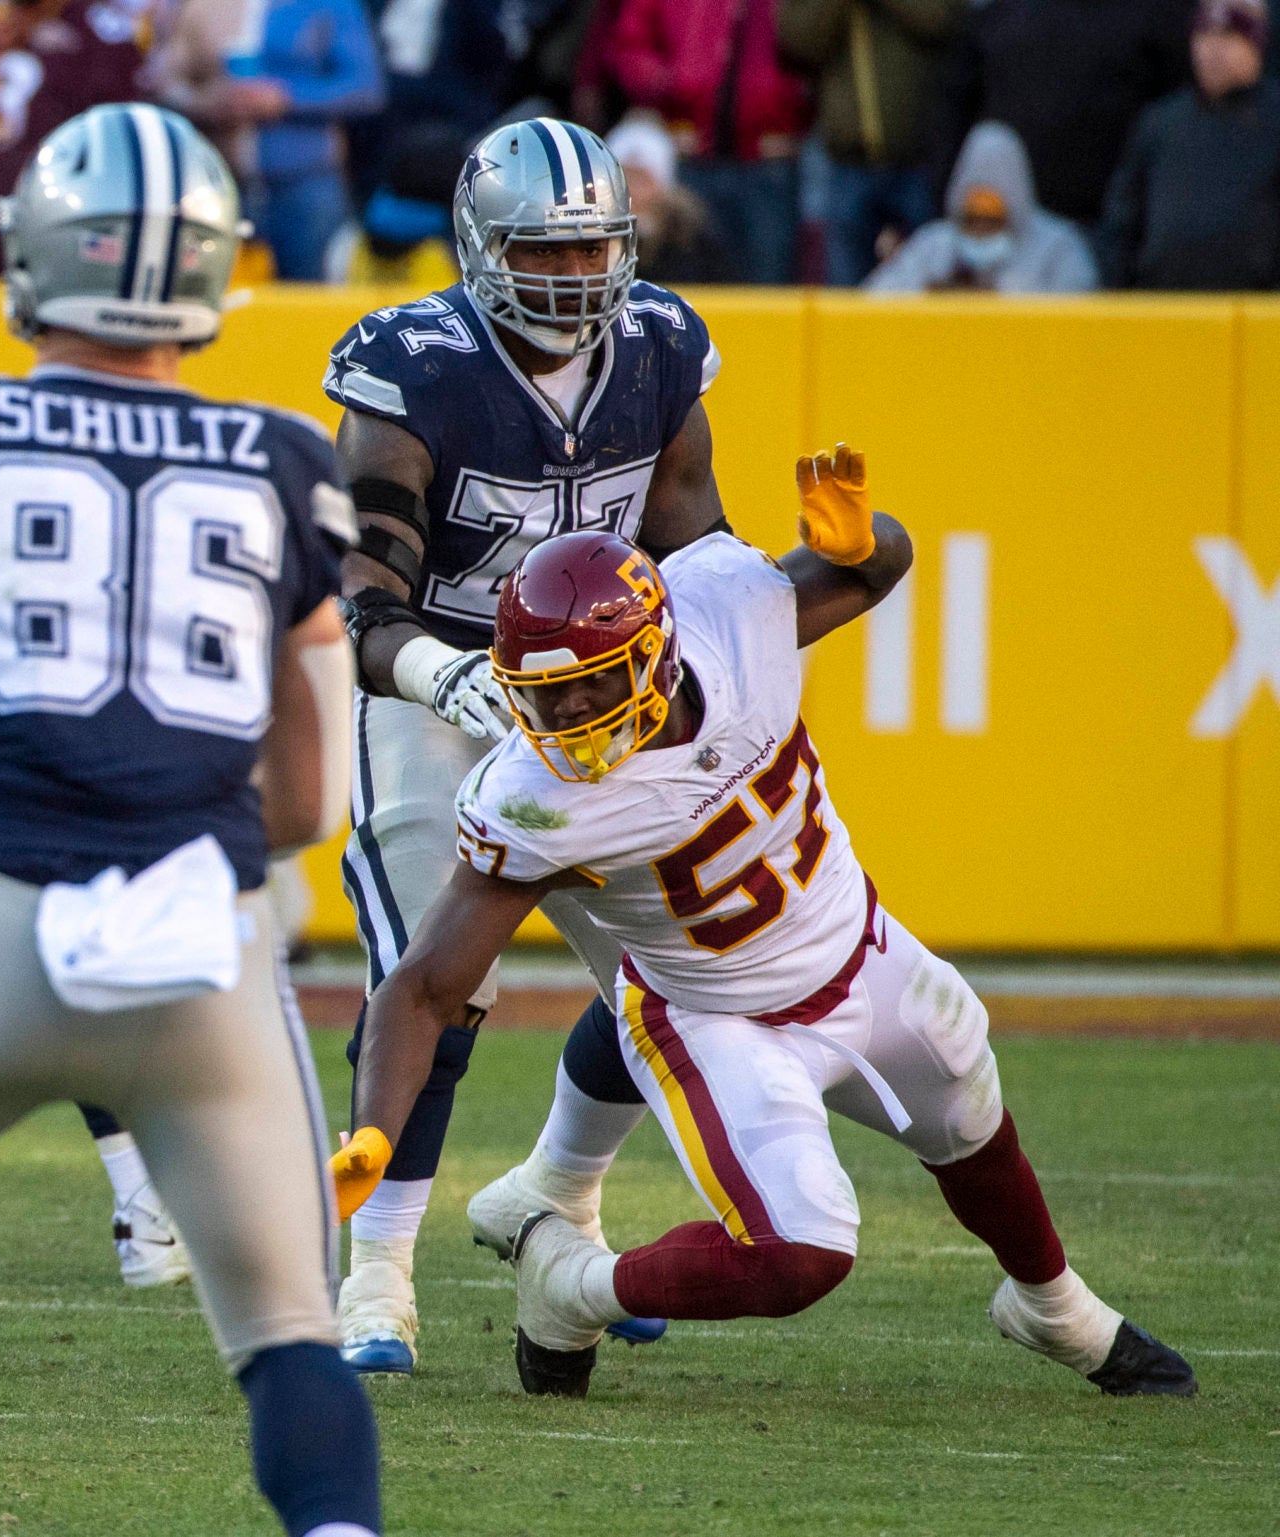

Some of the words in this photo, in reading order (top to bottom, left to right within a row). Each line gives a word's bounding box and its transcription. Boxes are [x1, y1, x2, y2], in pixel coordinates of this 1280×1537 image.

[558, 207, 593, 218] COWBOYS
[421, 450, 662, 626] 77
[616, 547, 668, 613] 57
[688, 735, 776, 821] WASHINGTON
[649, 716, 832, 955] 57
